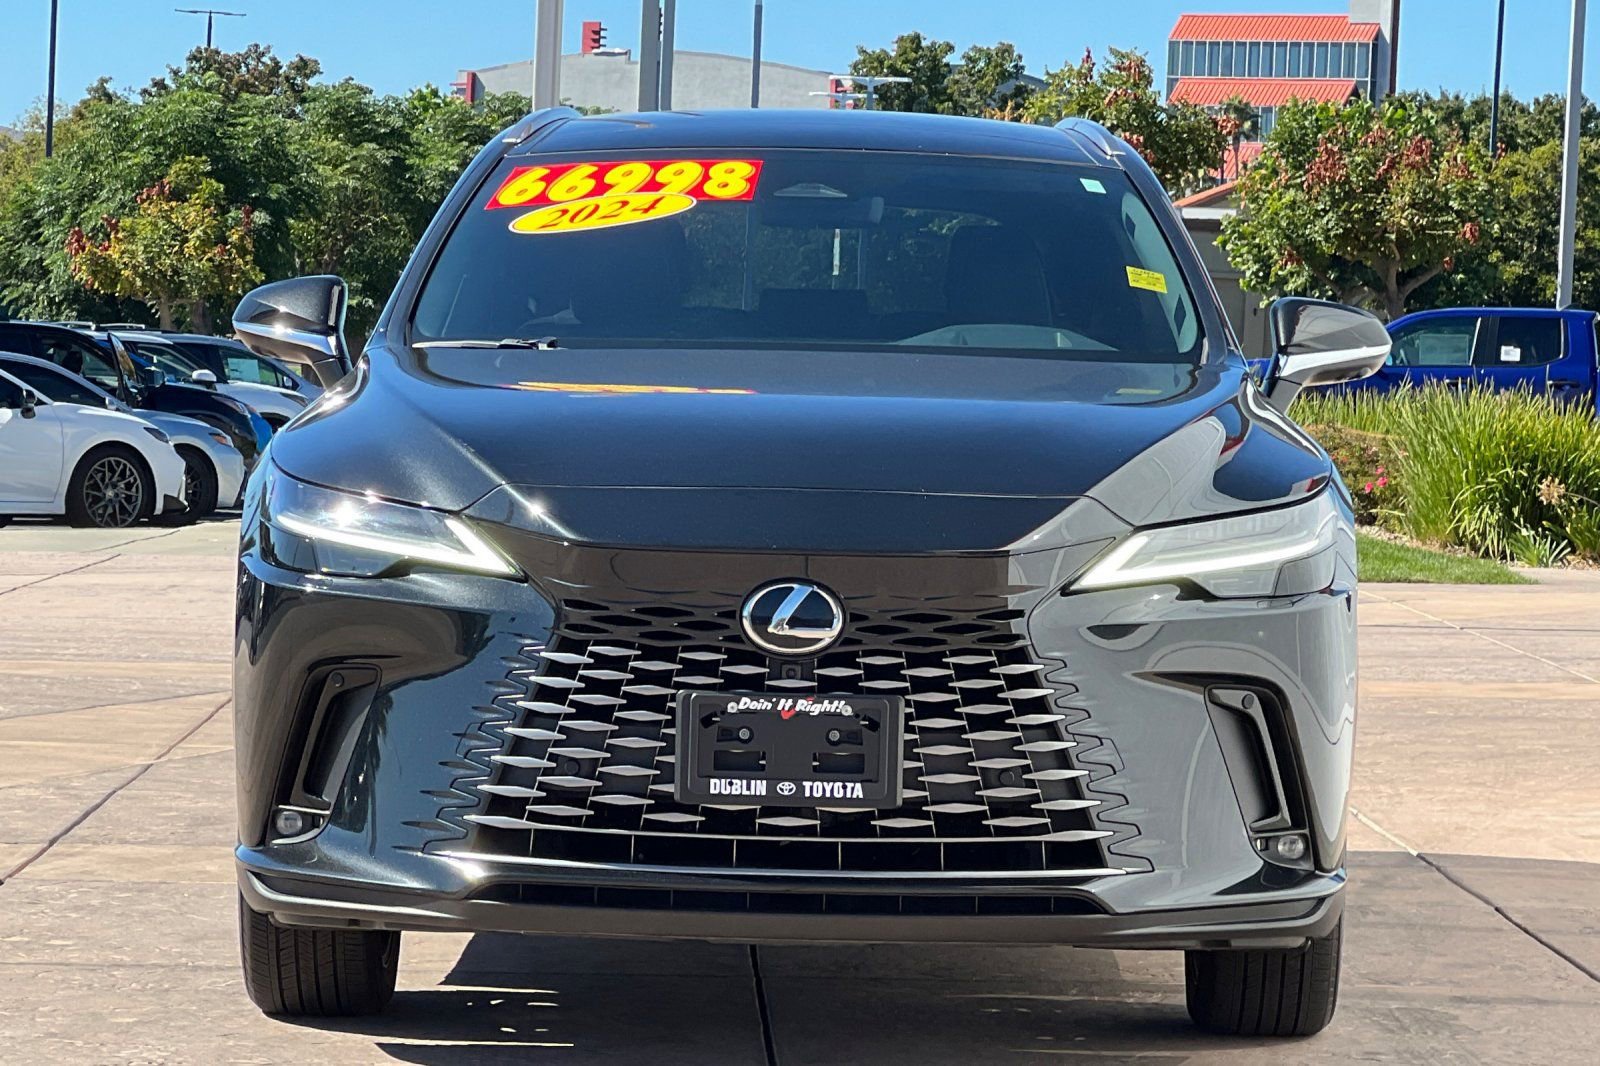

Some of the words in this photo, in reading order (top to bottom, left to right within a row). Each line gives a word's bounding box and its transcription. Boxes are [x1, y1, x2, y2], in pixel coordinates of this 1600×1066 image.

[496, 161, 755, 205] 66998
[536, 195, 666, 229] 2024
[738, 697, 777, 711] Doin'
[776, 698, 794, 711] It
[795, 699, 846, 716] Right!
[709, 778, 767, 796] DUBLIN
[803, 781, 864, 799] TOYOTA
